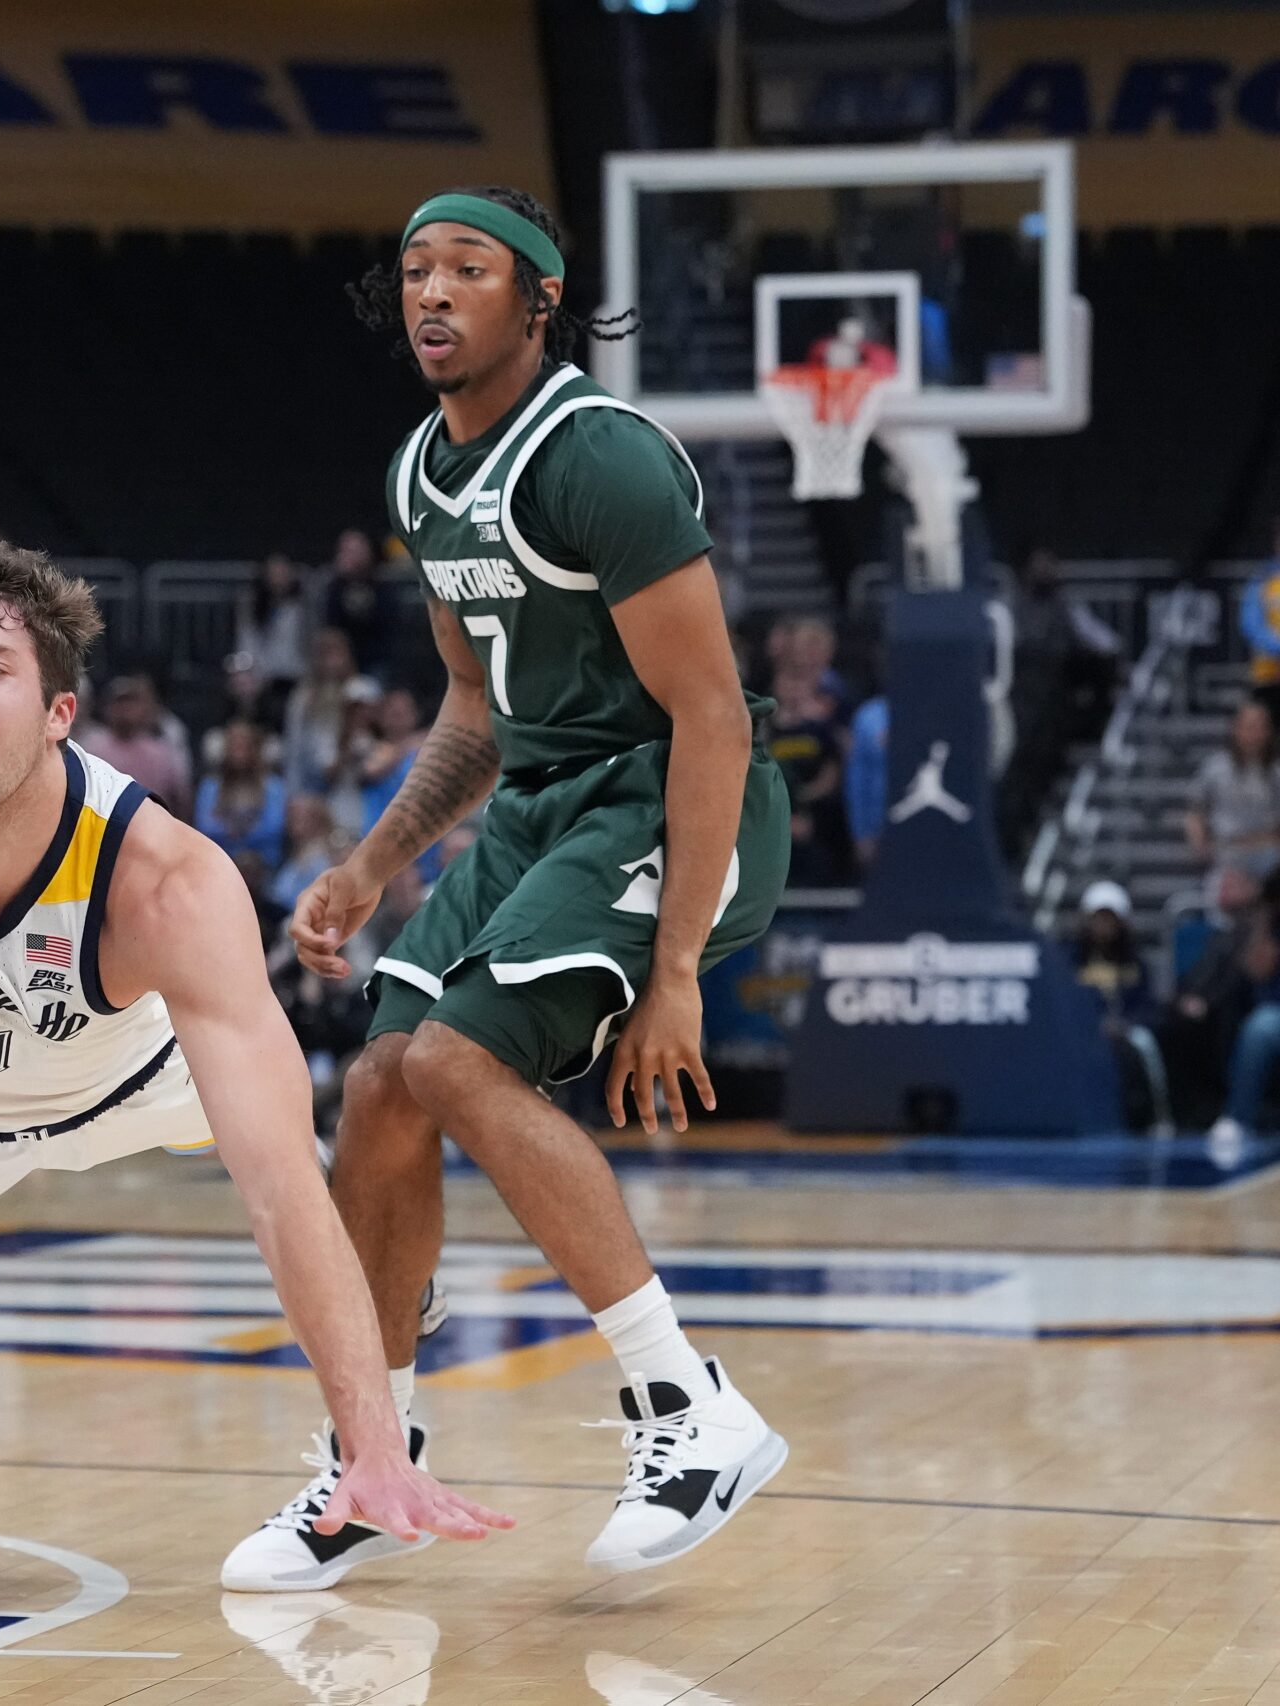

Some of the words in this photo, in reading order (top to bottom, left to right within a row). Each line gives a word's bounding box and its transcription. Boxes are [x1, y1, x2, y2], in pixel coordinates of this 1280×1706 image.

[463, 614, 513, 717] 7
[28, 978, 74, 992] EAST
[33, 969, 66, 982] BIG
[825, 977, 1031, 1026] GRUBER
